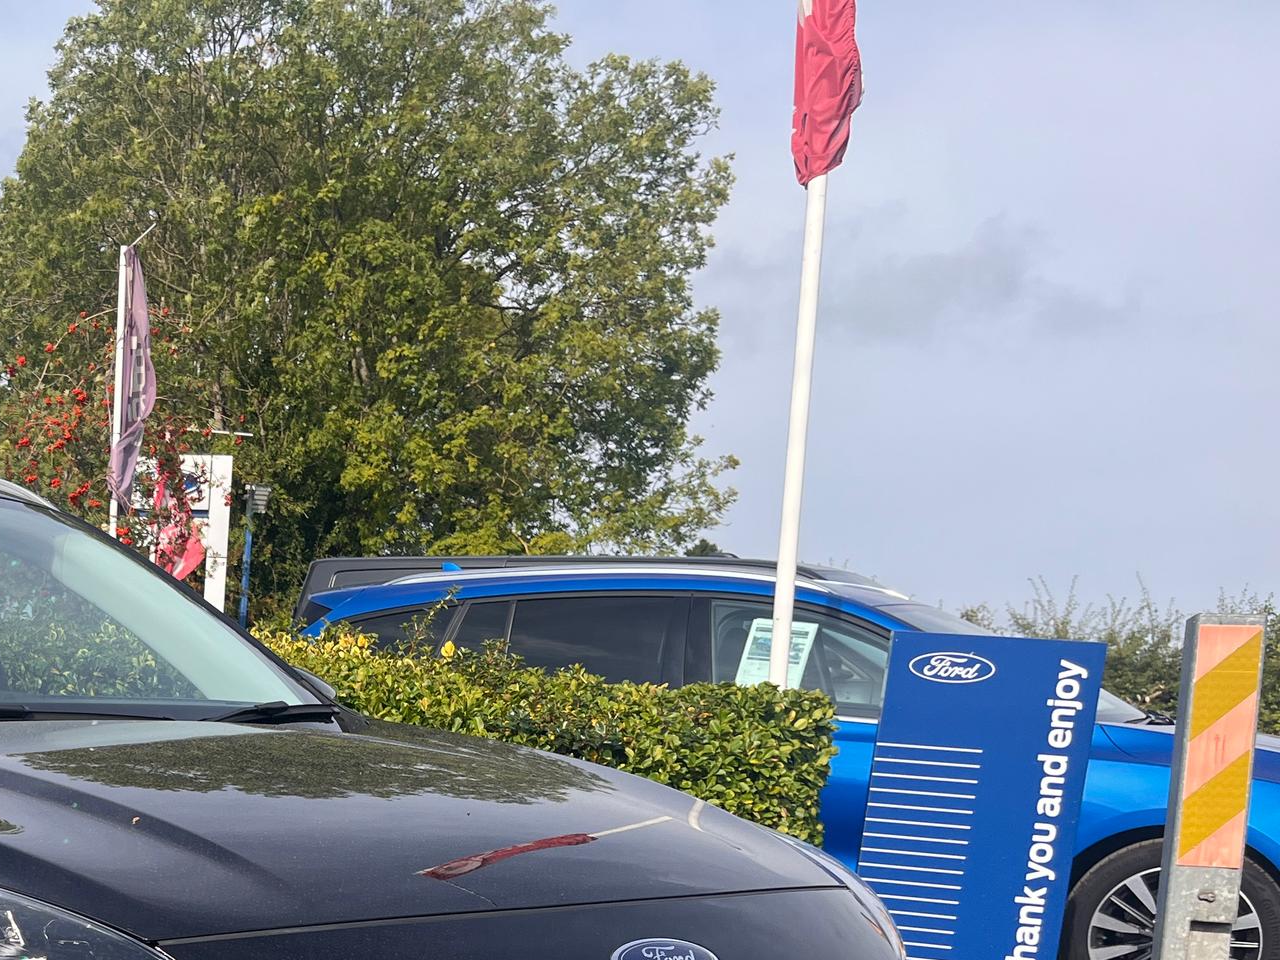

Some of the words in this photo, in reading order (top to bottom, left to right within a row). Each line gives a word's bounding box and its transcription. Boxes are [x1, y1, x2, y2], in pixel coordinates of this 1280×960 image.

[923, 655, 982, 679] Ford
[1046, 659, 1089, 748] enjoy
[1036, 754, 1068, 818] and
[1025, 822, 1057, 881] you
